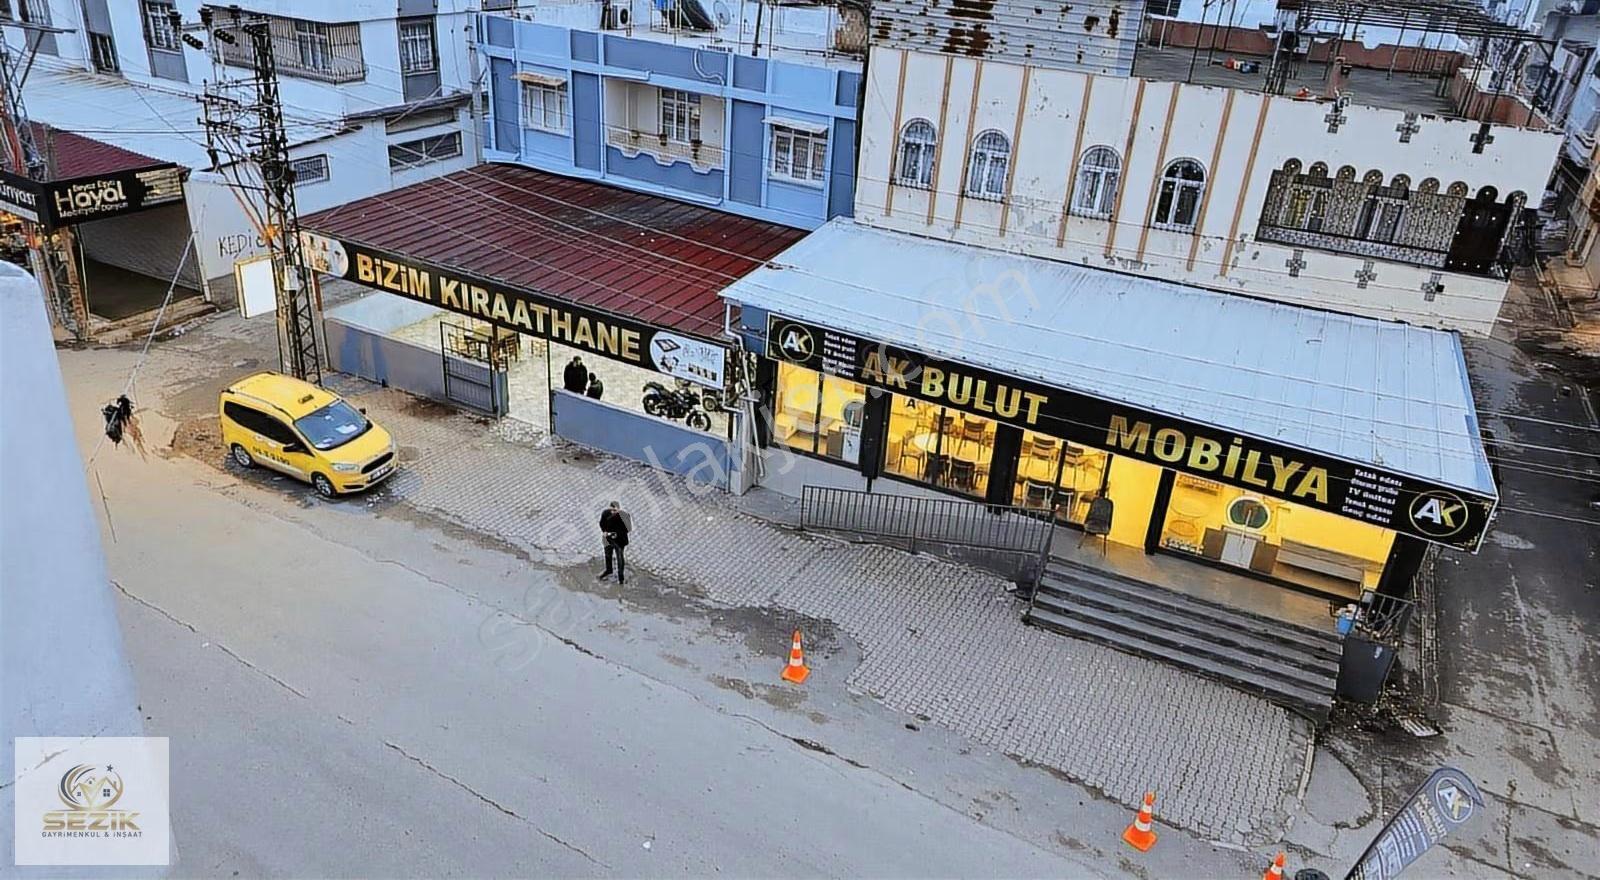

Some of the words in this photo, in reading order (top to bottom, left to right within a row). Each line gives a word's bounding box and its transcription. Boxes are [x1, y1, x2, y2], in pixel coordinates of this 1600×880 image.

[54, 180, 127, 211] Hayal
[440, 276, 640, 361] KIRAATHANE
[783, 330, 810, 354] AK
[861, 352, 910, 389] AK
[921, 367, 1048, 424] BULUT
[1106, 414, 1328, 504] MOBİLYA
[1414, 498, 1463, 528] AK
